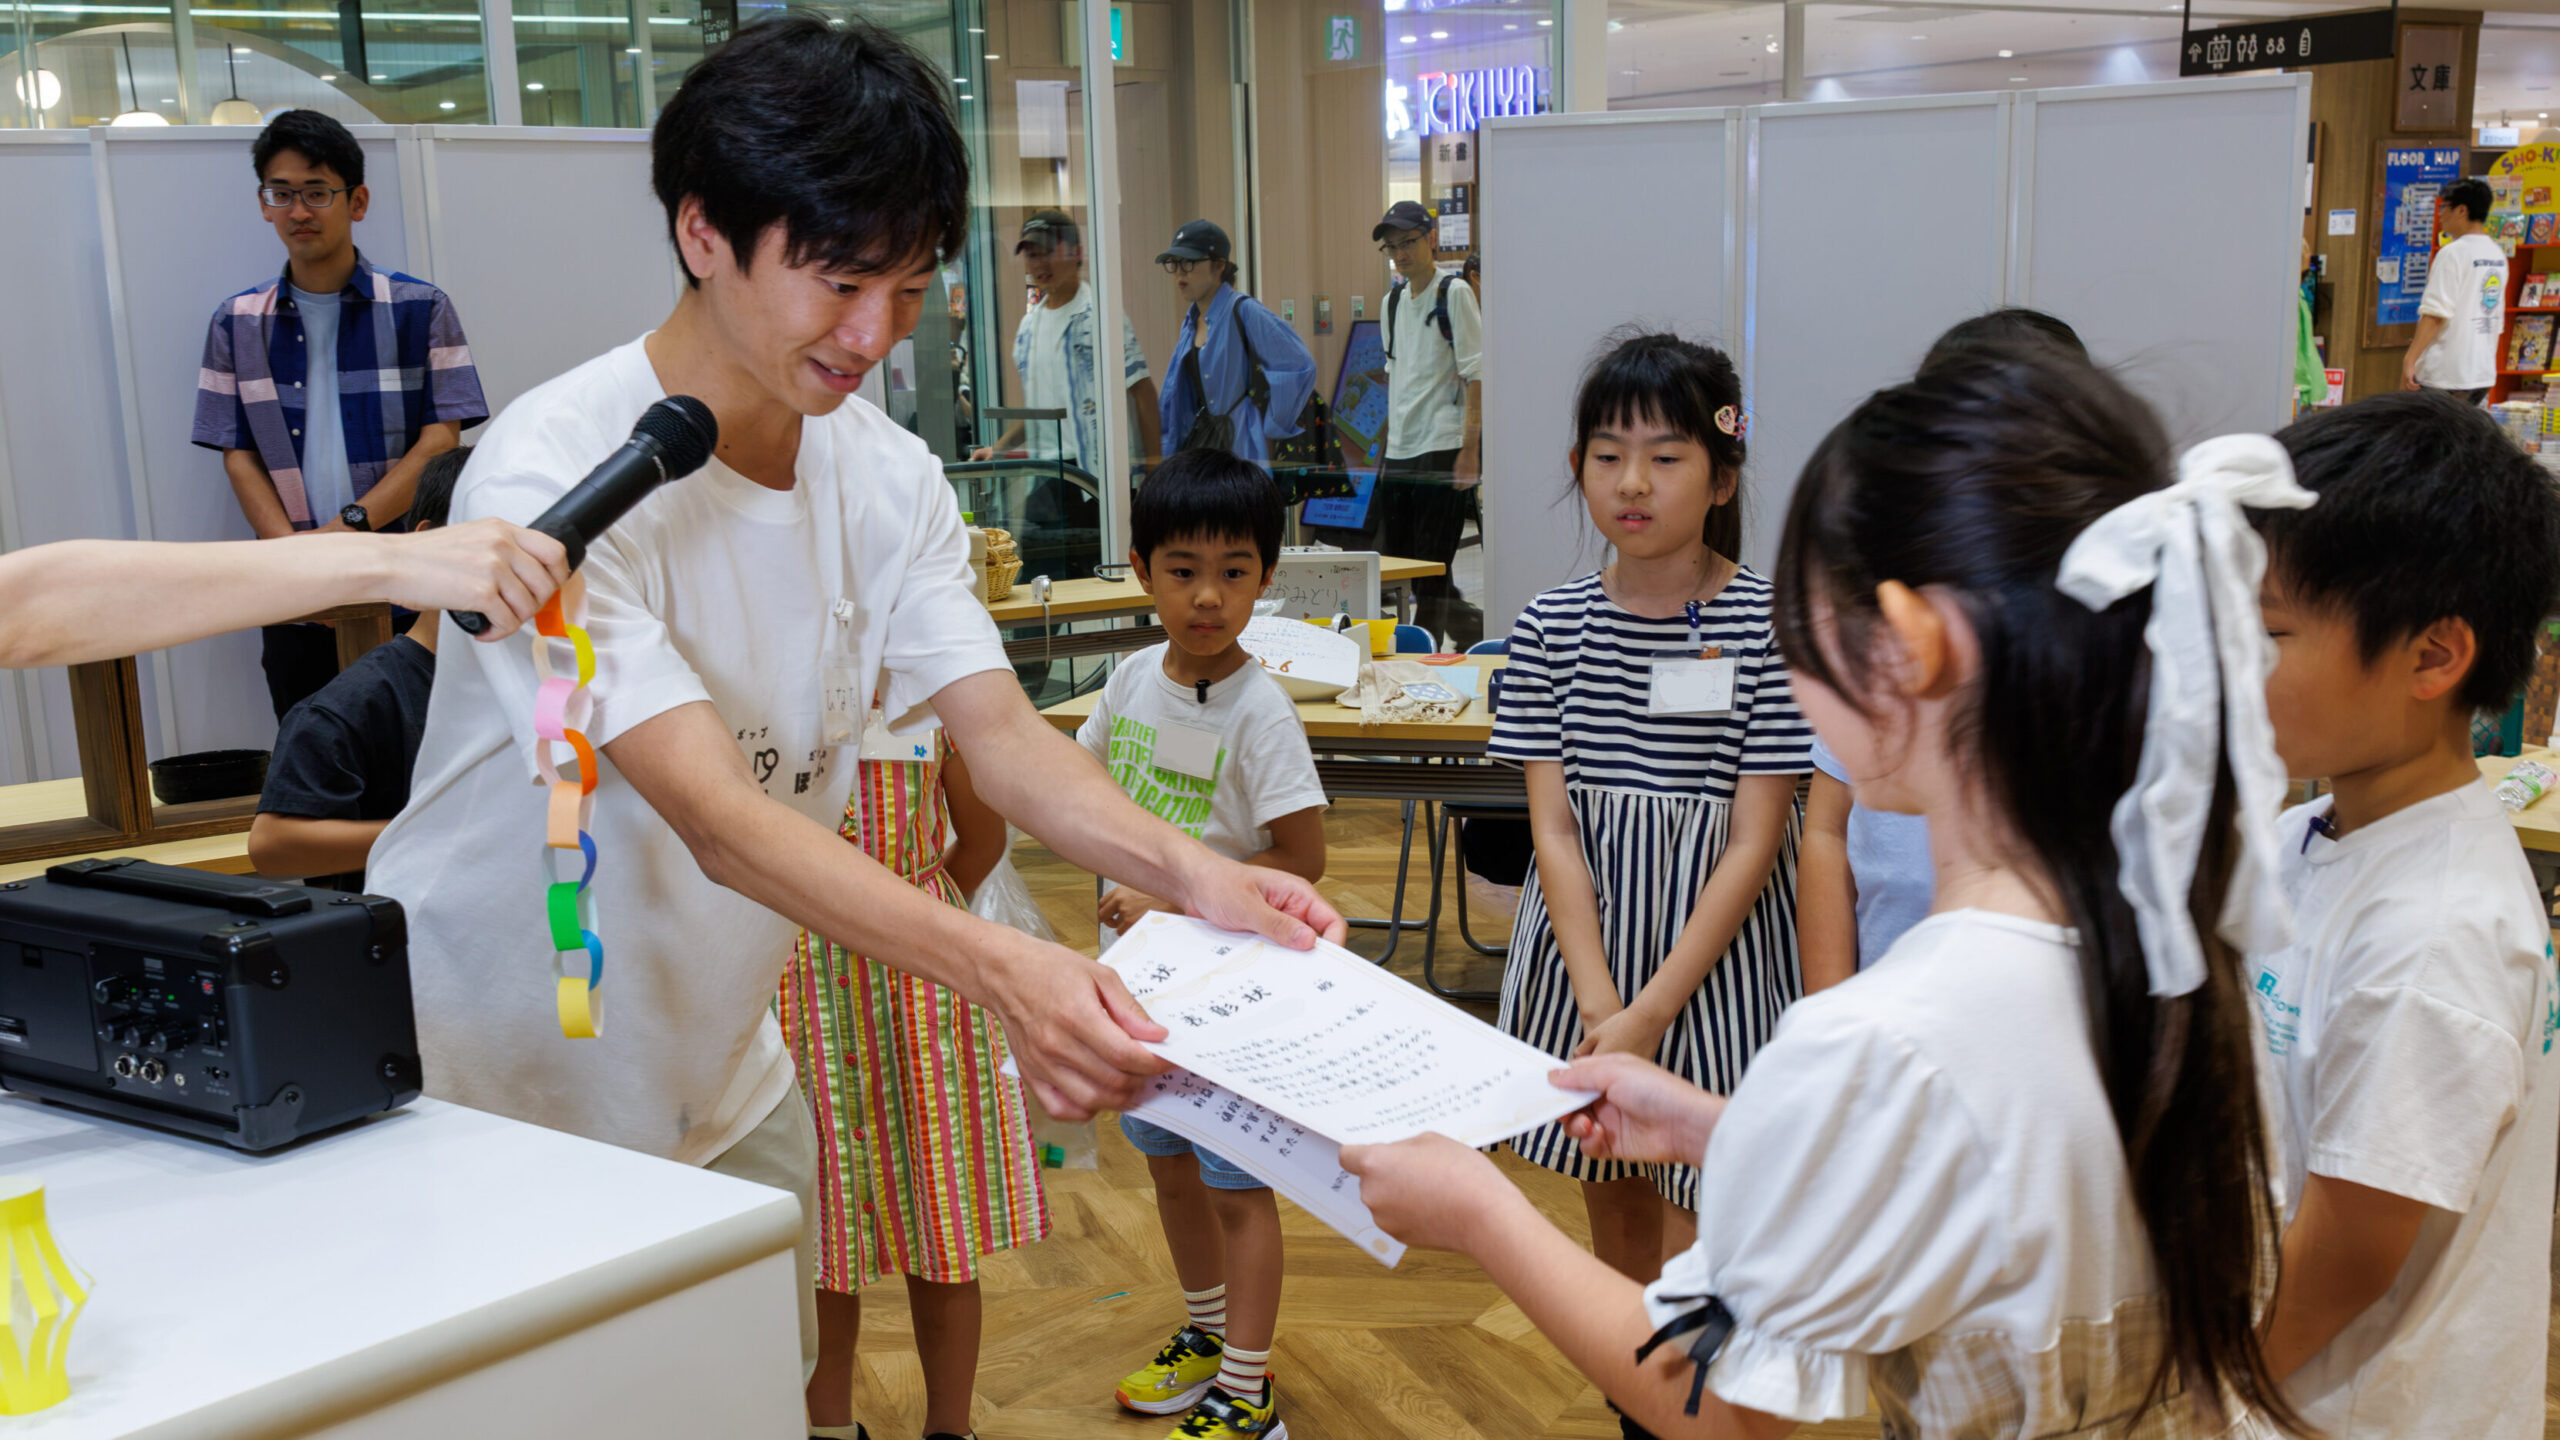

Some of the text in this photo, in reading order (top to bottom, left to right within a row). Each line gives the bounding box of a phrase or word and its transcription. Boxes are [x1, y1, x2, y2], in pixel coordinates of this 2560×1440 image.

[2409, 63, 2451, 92] 文庫
[1438, 142, 1467, 161] 新書
[2387, 151, 2460, 166] FLOOR MAP
[1181, 984, 1272, 1027] 表彰状
